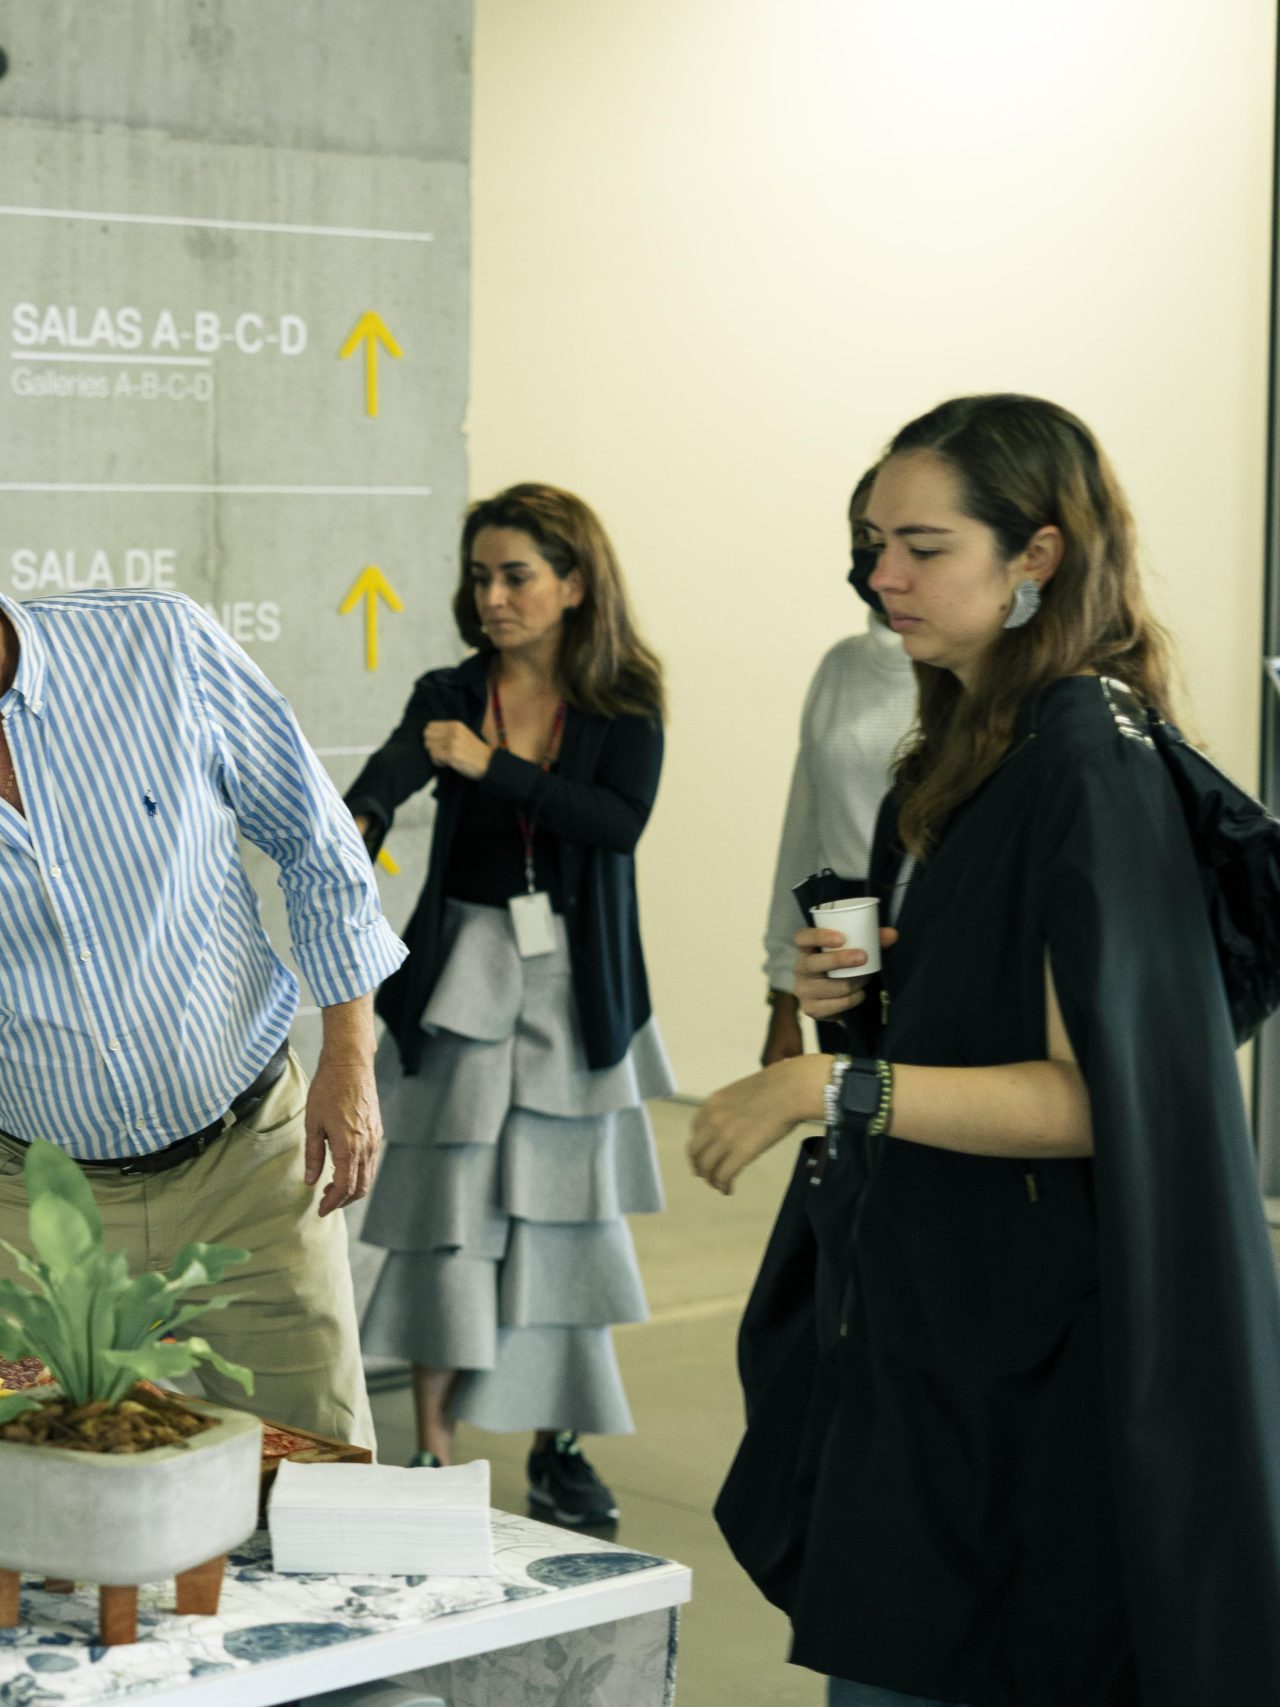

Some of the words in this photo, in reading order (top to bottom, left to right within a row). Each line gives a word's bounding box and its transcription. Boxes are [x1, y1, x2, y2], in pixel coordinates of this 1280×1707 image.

[12, 303, 141, 348] SALAS
[152, 311, 307, 355] A-B-C-D
[115, 372, 214, 401] A-B-C-D
[12, 549, 114, 590] SALA
[126, 550, 176, 588] DE
